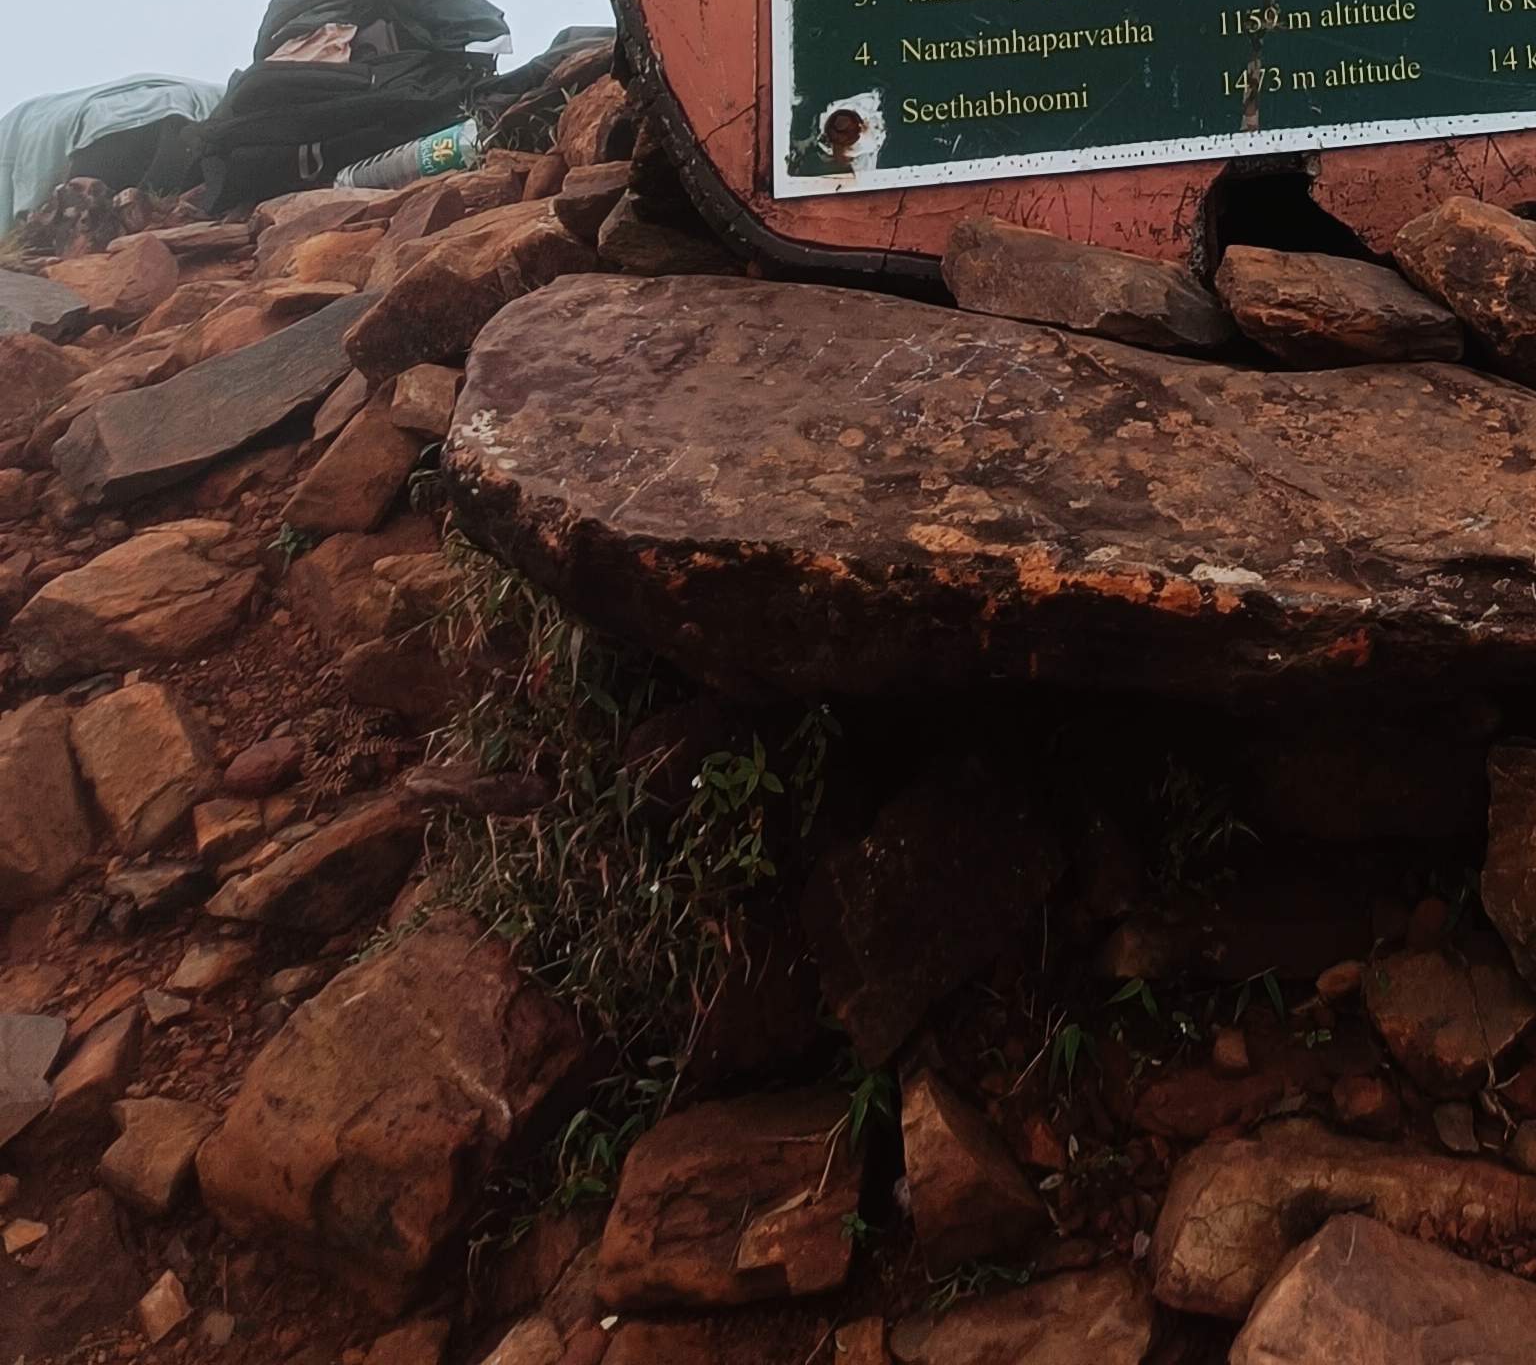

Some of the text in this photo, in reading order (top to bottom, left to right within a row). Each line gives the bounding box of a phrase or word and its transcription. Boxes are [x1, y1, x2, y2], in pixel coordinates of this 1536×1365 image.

[1289, 10, 1312, 29] m
[854, 19, 1154, 66] 4. Narasimhaparvatha
[1490, 46, 1517, 72] 14
[1293, 70, 1316, 90] m
[1325, 56, 1421, 86] altitude
[901, 83, 1089, 123] Seethabhoomi
